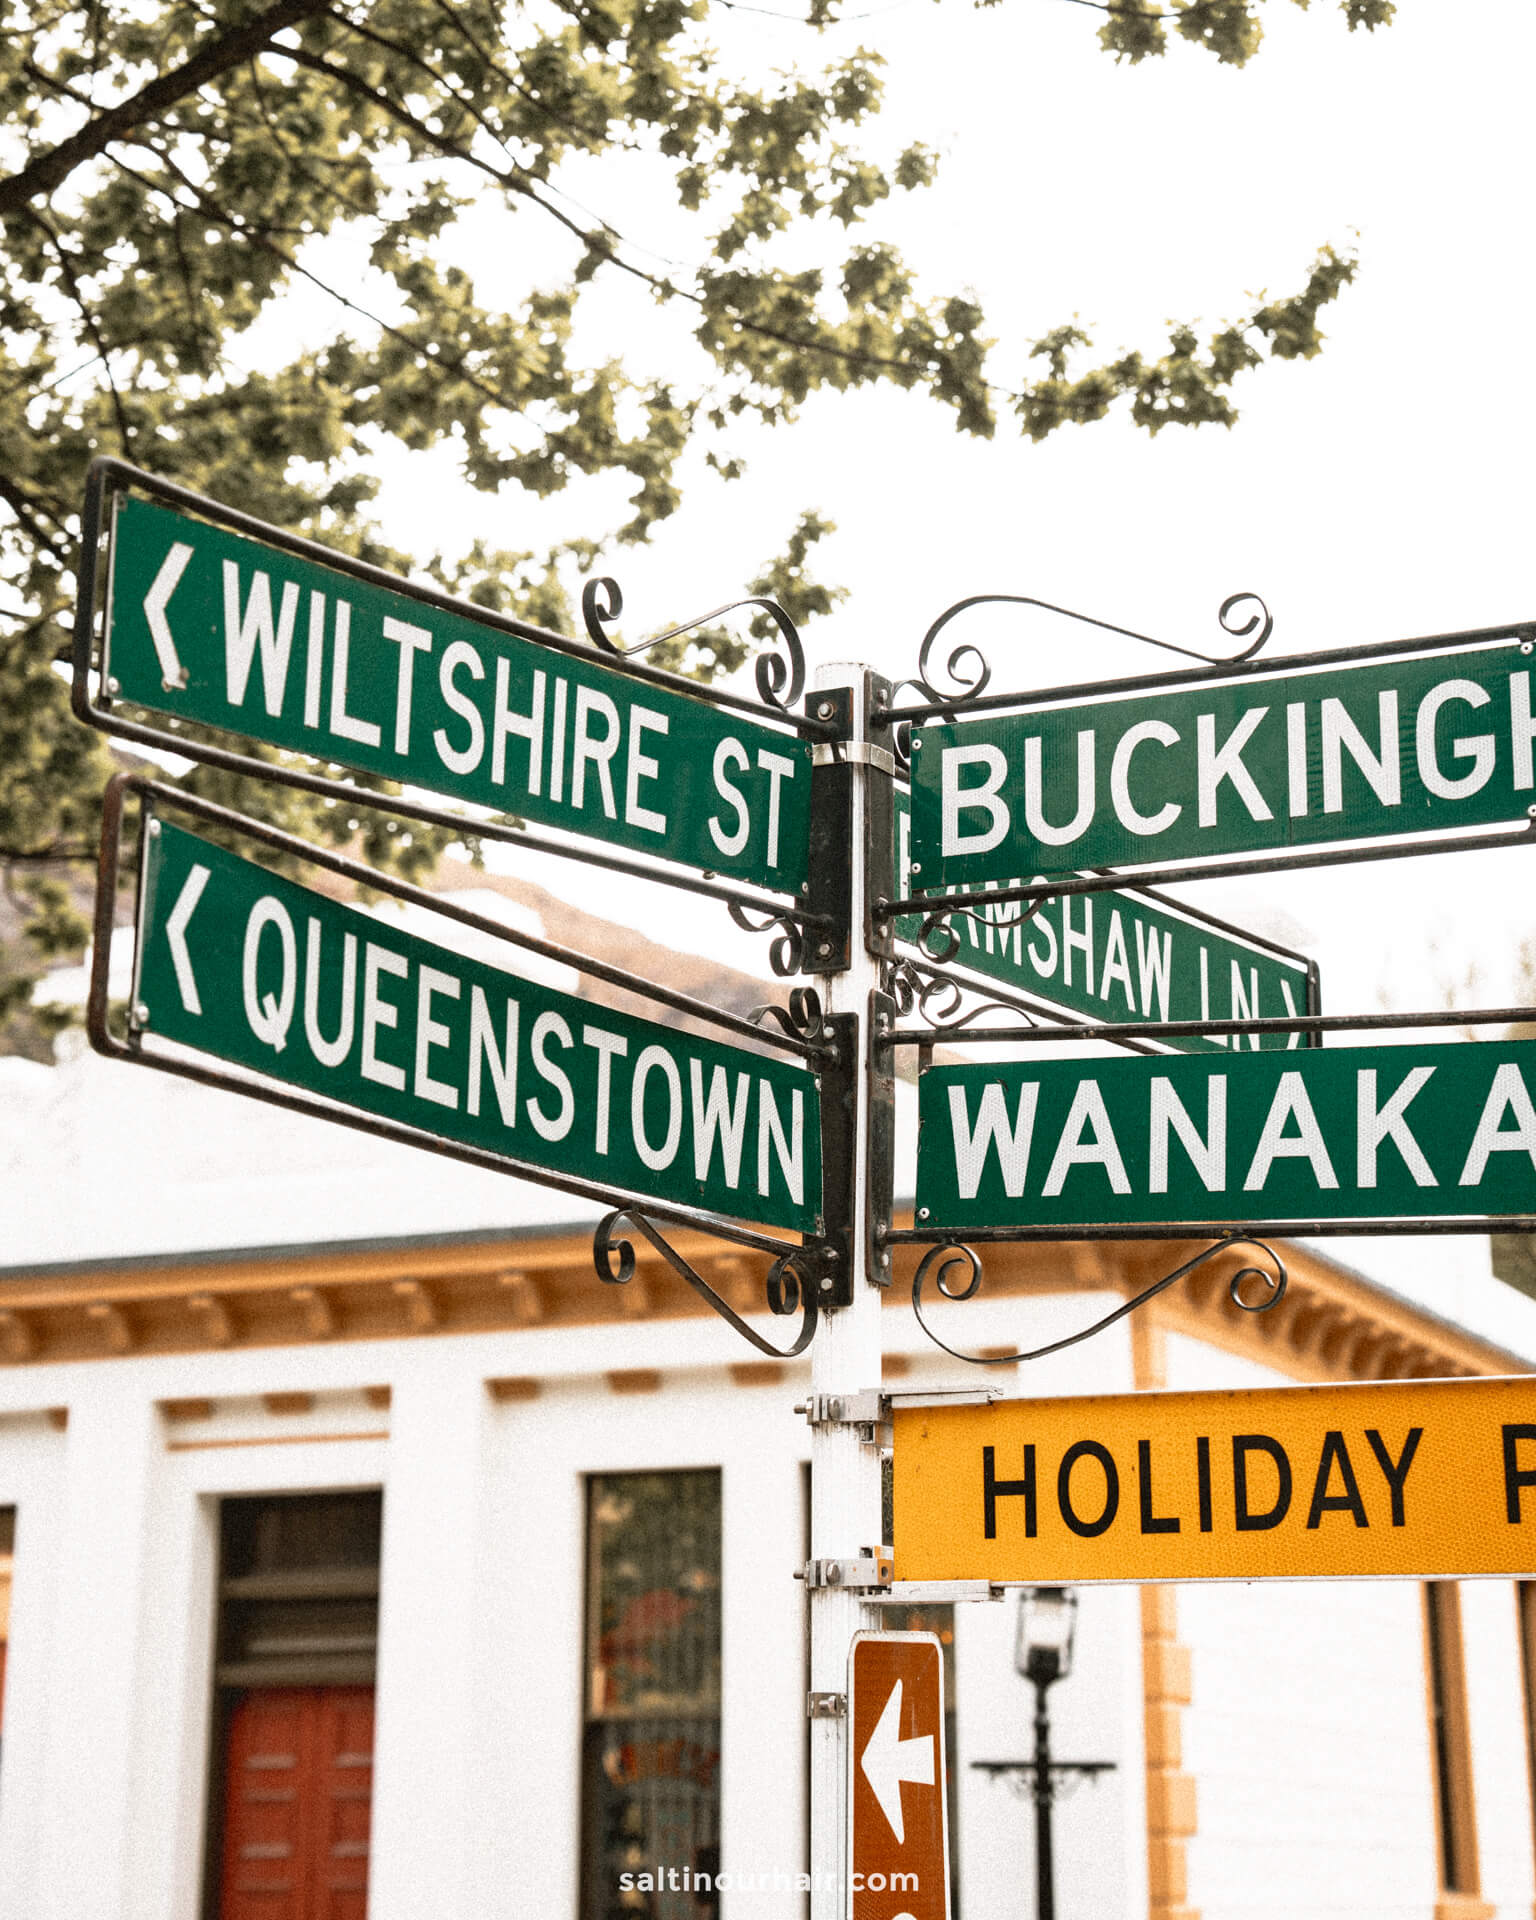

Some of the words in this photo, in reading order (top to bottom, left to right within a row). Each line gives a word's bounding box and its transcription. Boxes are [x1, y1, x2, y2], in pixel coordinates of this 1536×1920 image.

[222, 560, 669, 834] WILTSHIRE
[708, 736, 795, 868] ST
[242, 896, 804, 1206] QUEENSTOWN
[947, 1063, 1536, 1199] WANAKA
[983, 1427, 1424, 1539] HOLIDAY
